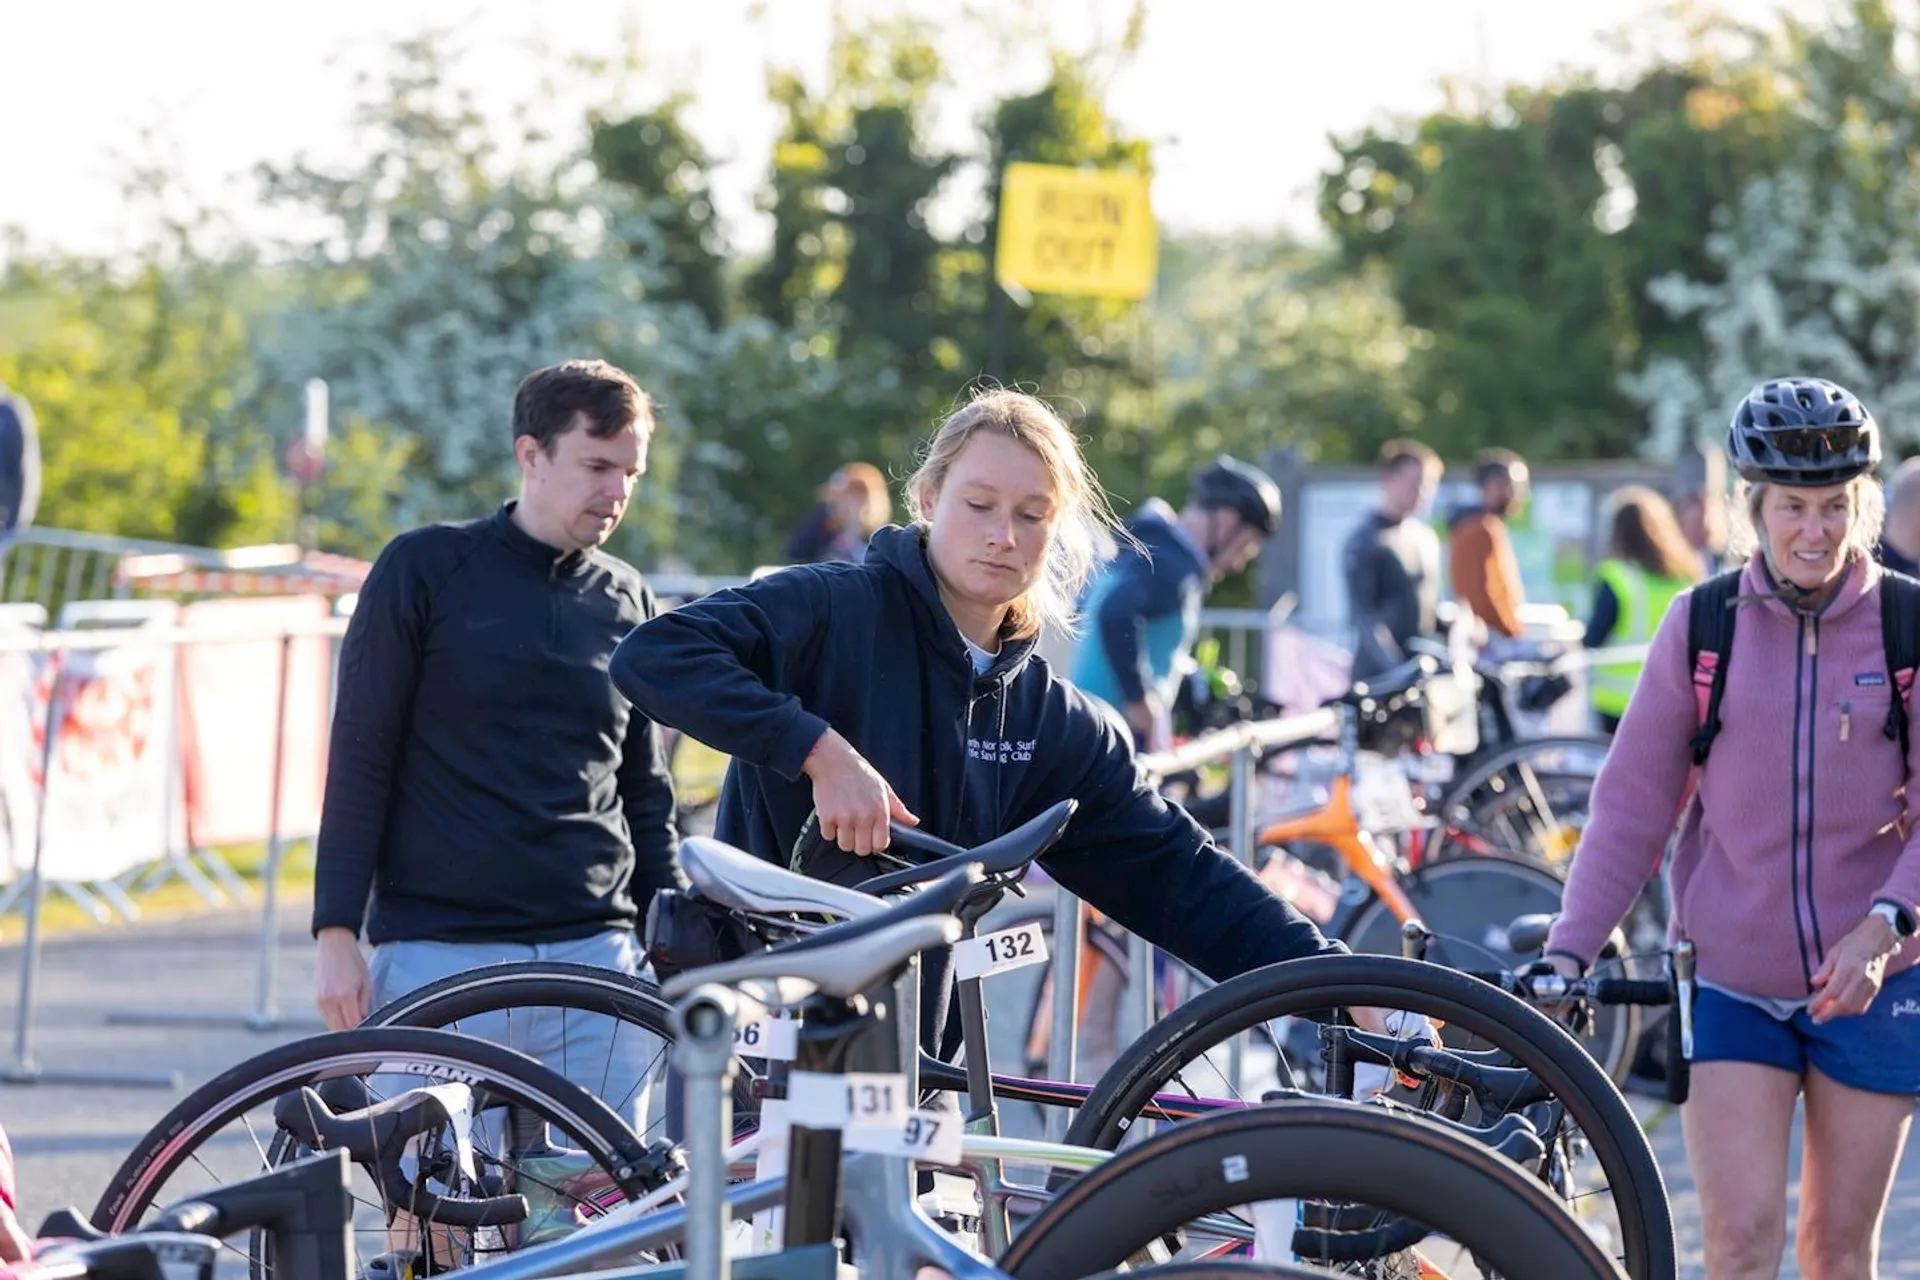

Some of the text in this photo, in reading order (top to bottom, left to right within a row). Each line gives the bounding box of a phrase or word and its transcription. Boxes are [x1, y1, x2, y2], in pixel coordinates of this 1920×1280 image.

[1034, 186, 1125, 226] RUN
[1033, 232, 1118, 273] OUT
[982, 741, 1013, 751] Norolk
[1017, 739, 1036, 750] Surf
[1011, 751, 1032, 761] Club
[985, 931, 1034, 962] 132
[406, 1062, 485, 1086] GIANT
[847, 1084, 892, 1115] 131
[903, 1116, 941, 1146] 97
